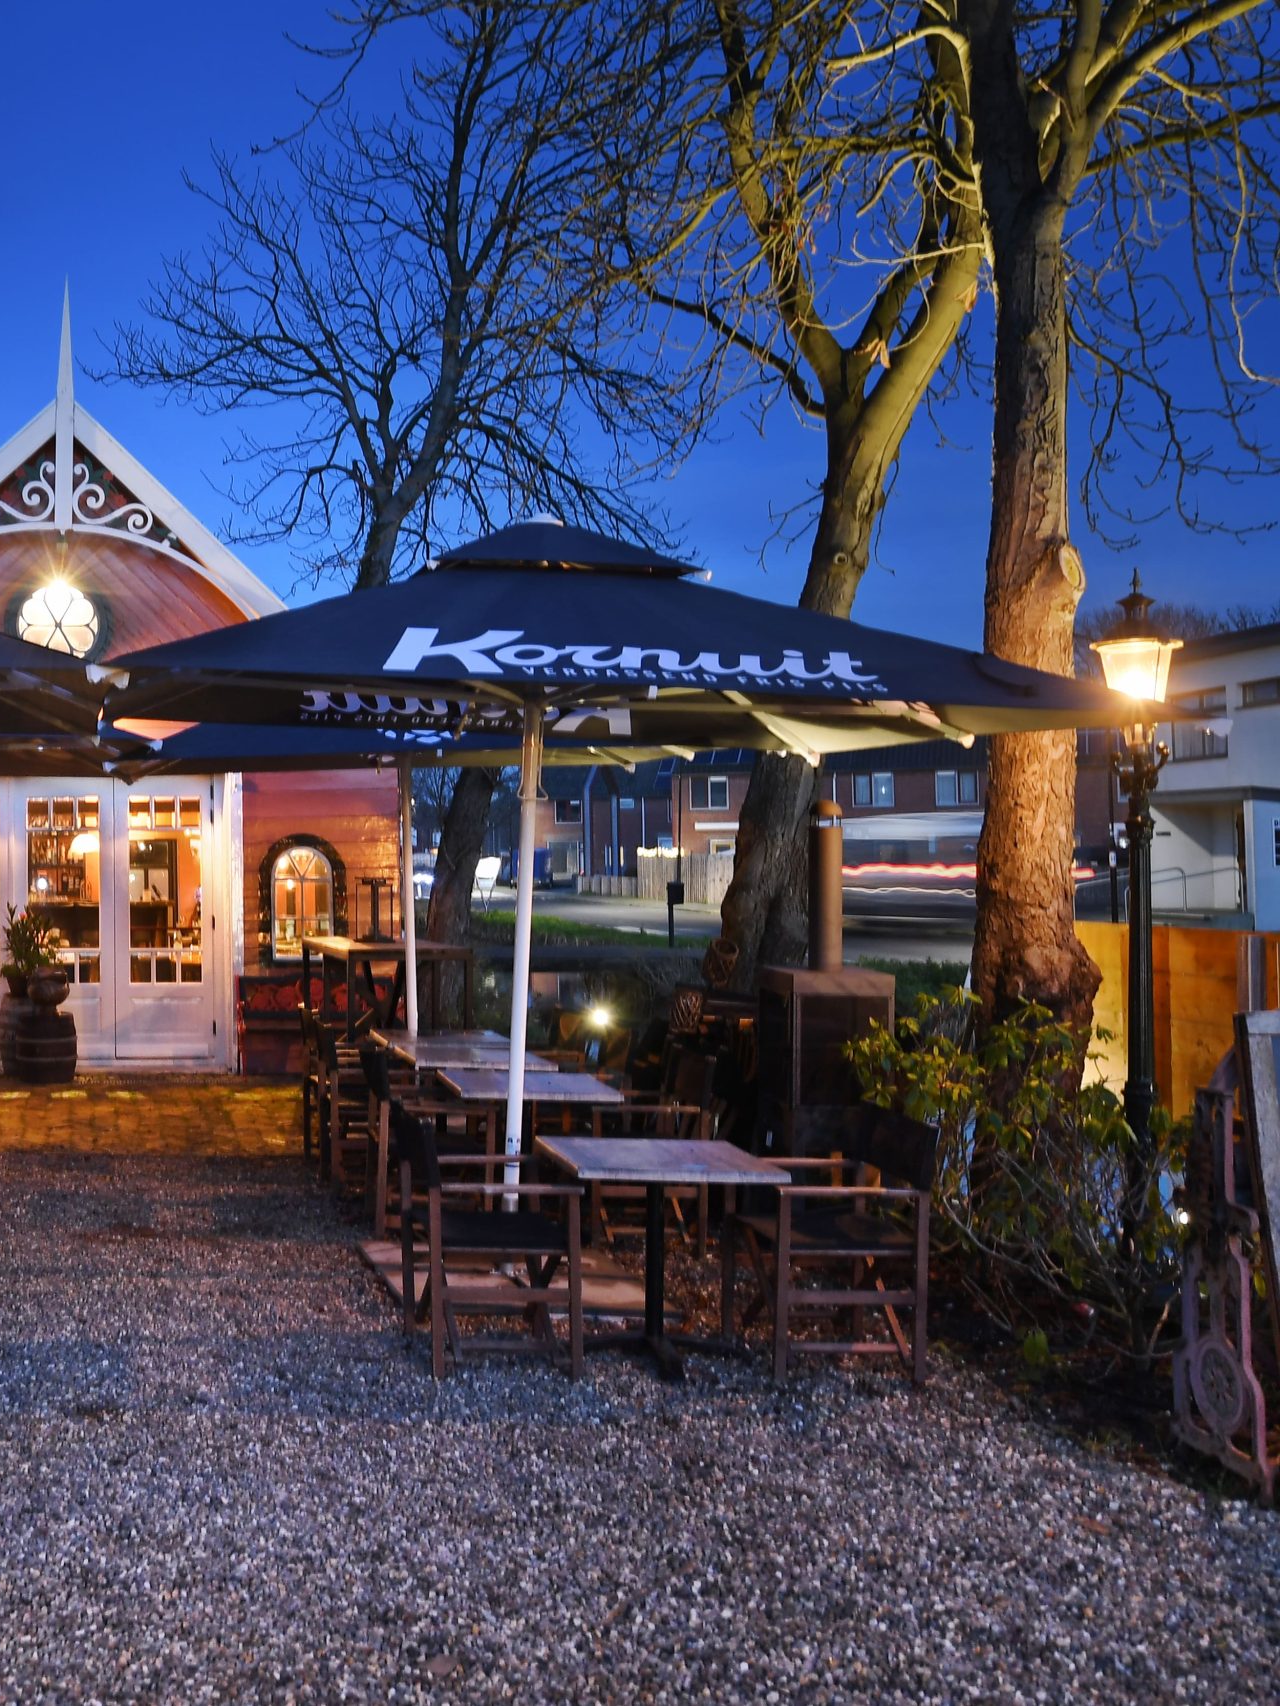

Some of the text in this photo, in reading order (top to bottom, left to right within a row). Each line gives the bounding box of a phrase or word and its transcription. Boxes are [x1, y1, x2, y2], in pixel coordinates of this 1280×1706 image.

[383, 627, 878, 682] Kornuit
[521, 665, 889, 692] VERRASSEND FRIS PILS
